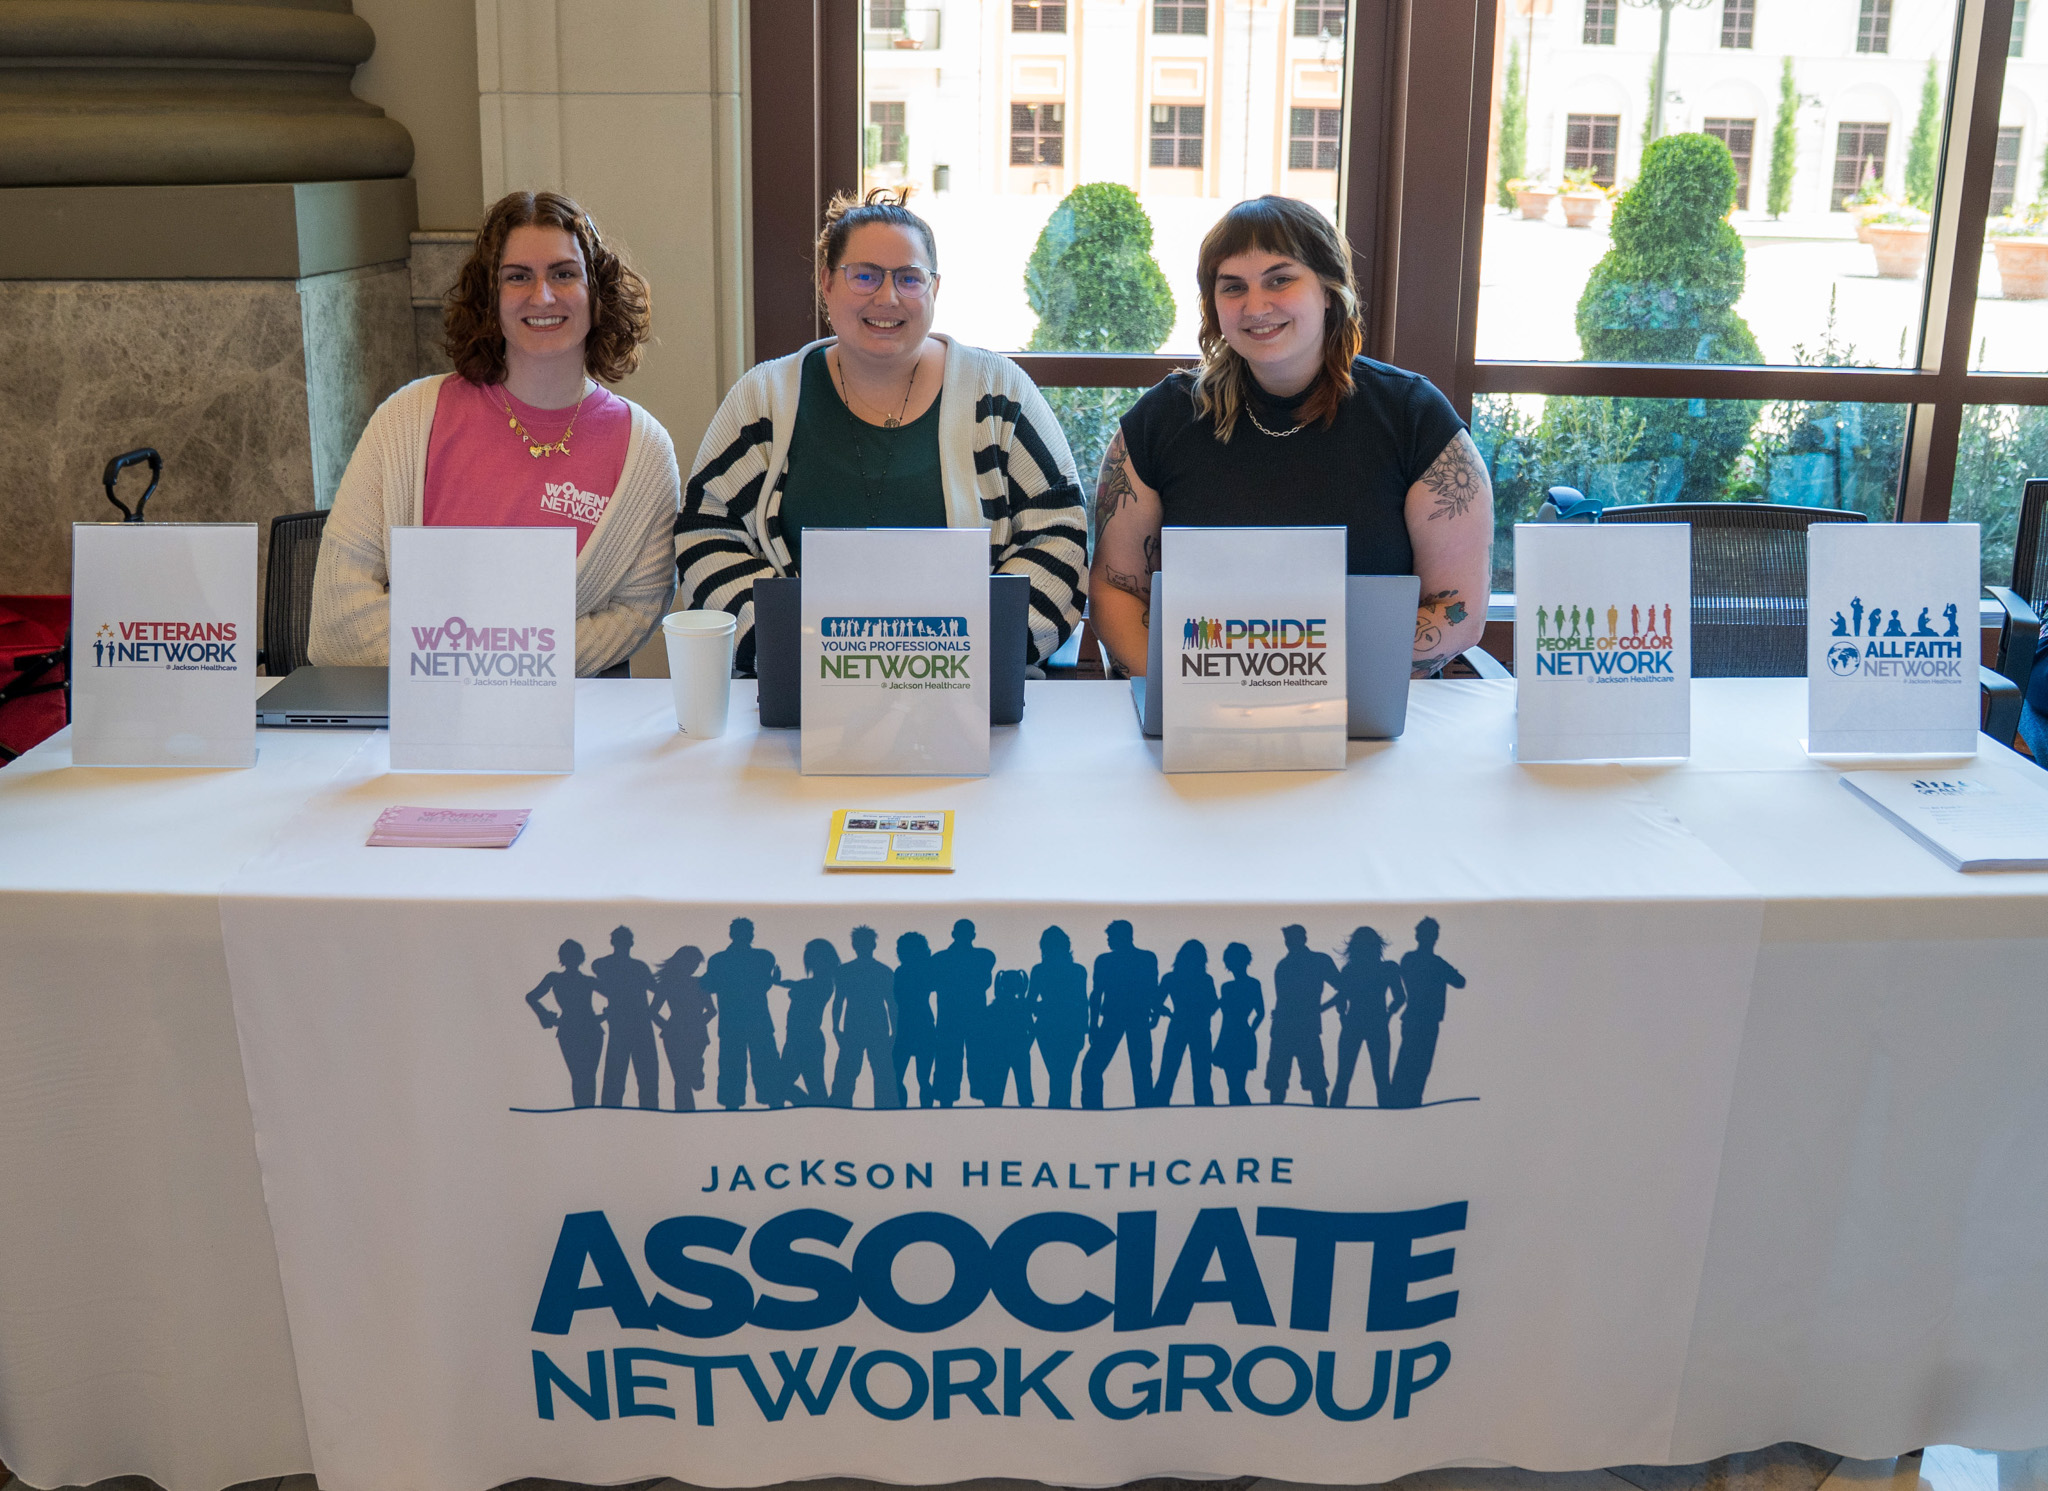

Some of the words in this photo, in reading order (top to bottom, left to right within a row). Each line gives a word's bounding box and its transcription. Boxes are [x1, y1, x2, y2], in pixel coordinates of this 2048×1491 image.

[545, 481, 610, 509] WOMEN'
[540, 495, 604, 521] NETWOR
[118, 621, 237, 641] VETERANS
[411, 616, 556, 652] WOMEN'S
[1226, 619, 1327, 650] PRIDE
[118, 642, 237, 663] NETWORK
[821, 641, 867, 652] YOUNG
[870, 641, 971, 652] PROFESSIONALS
[1536, 637, 1595, 651] PEOPLE
[1597, 637, 1618, 650] OF
[1619, 636, 1673, 650] COLOR
[1865, 641, 1903, 658] ALL
[1904, 641, 1962, 659] FAITH
[410, 652, 556, 677] NETWORK
[821, 655, 970, 679] NETWORK
[1182, 652, 1327, 677] NETWORK
[1536, 651, 1674, 676] NETWORK
[1864, 660, 1962, 677] NETWORK
[473, 678, 508, 687] Jackson
[510, 678, 557, 687] Healthcare
[889, 682, 923, 690] Jackson
[925, 682, 971, 690] Healthcare
[1249, 679, 1282, 687] Jackson
[1283, 678, 1328, 687] Healthcare
[1596, 675, 1629, 684] Jackson
[1630, 674, 1675, 683] Healthcare
[701, 1159, 932, 1193] JACKSON
[963, 1157, 1293, 1190] HEALTHCARE
[531, 1200, 1469, 1339] ASSOCIATE
[531, 1345, 1075, 1427] NETWORK
[1088, 1341, 1452, 1422] GROUP
